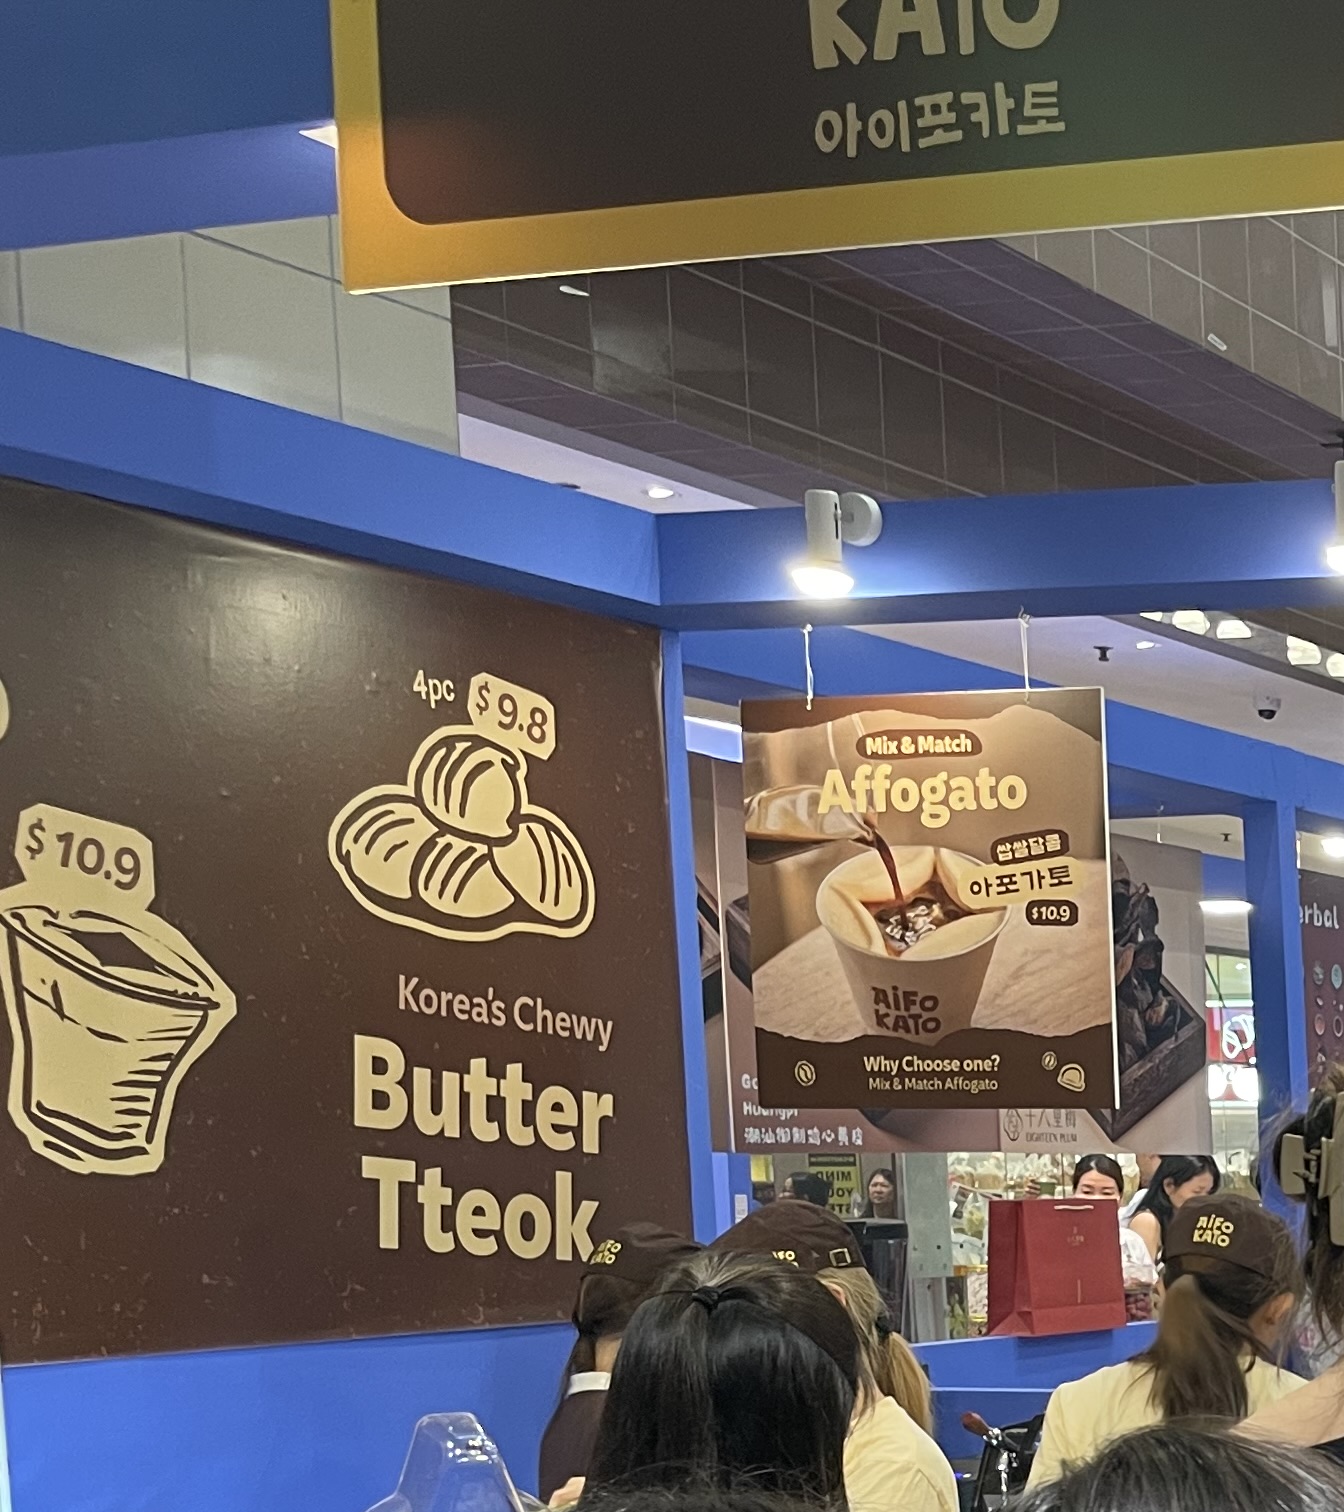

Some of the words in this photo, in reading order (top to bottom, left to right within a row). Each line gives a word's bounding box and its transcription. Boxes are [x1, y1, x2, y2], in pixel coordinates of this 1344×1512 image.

[815, 81, 1066, 158] 아이포카토
[412, 669, 456, 706] 4pc
[476, 681, 549, 746] $9.8
[866, 736, 898, 755] Mix
[900, 735, 916, 754] &
[918, 734, 972, 754] Match
[817, 764, 1028, 828] Affogato
[26, 819, 142, 891] $10.9
[969, 866, 1073, 898] 아포가토
[1031, 906, 1070, 922] $10.9
[1299, 902, 1339, 930] rbal
[398, 974, 506, 1027] Korea's
[513, 987, 613, 1052] Chewy
[874, 1009, 941, 1036] KATO
[864, 1057, 899, 1076] Why
[902, 1056, 960, 1073] Choose
[963, 1056, 1000, 1072] one?
[354, 1034, 614, 1155] Butter
[868, 1077, 891, 1091] Mix
[894, 1077, 903, 1090] &
[906, 1077, 942, 1091] Match
[944, 1076, 998, 1093] Affogato
[361, 1156, 598, 1262] Tteok
[1193, 1229, 1230, 1247] KATO
